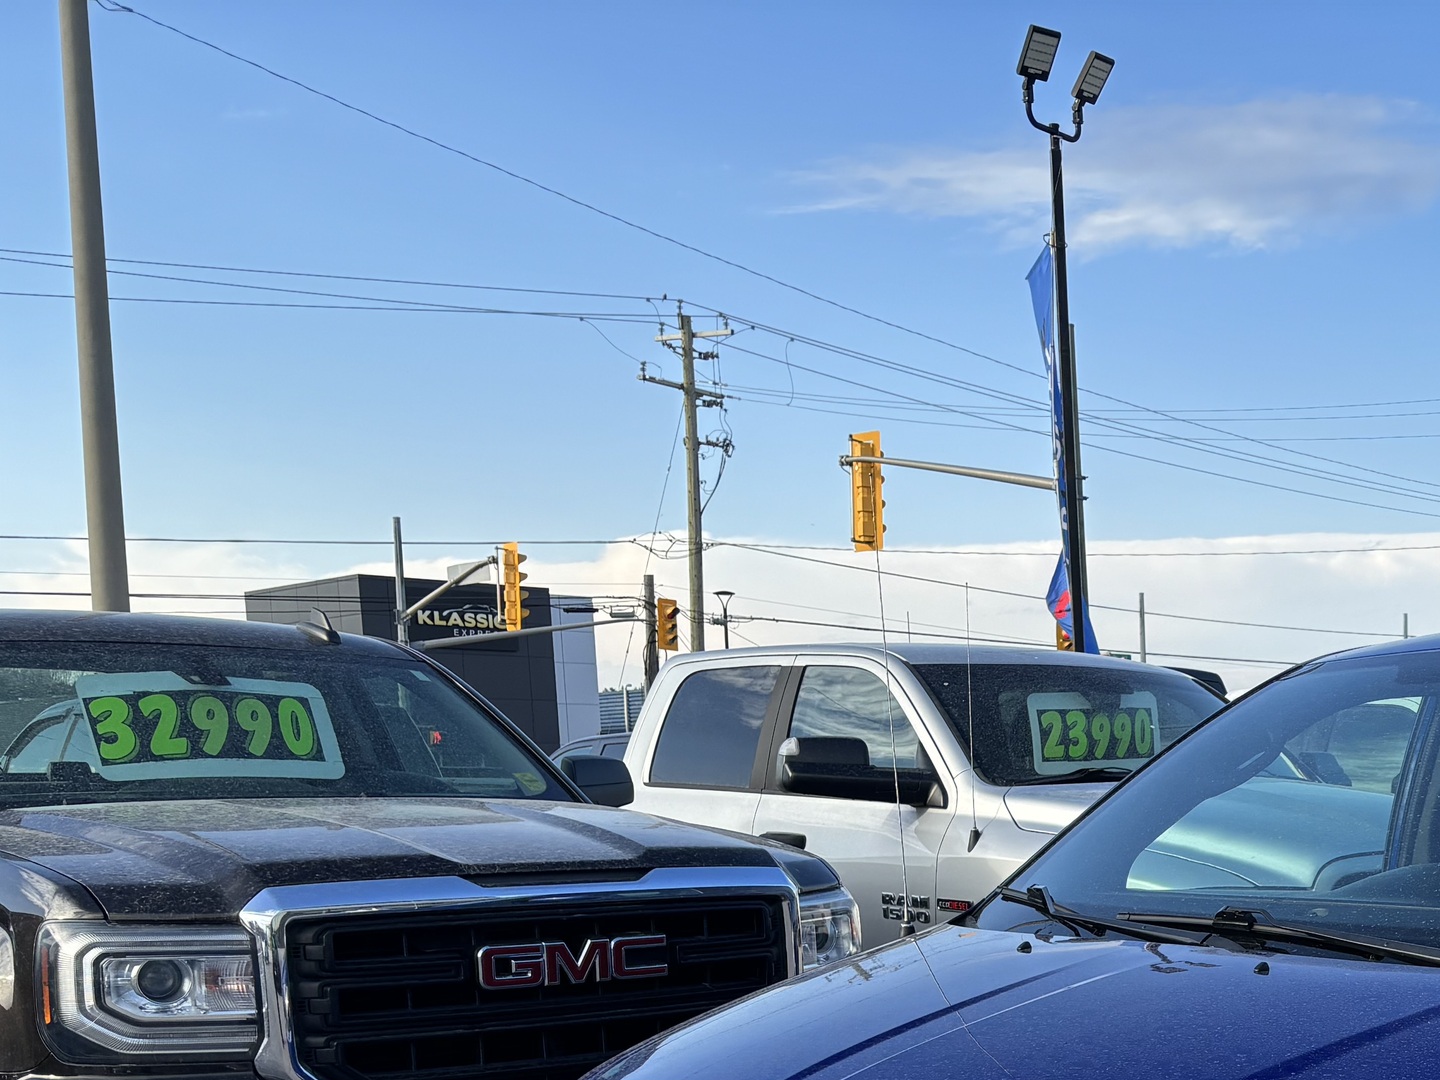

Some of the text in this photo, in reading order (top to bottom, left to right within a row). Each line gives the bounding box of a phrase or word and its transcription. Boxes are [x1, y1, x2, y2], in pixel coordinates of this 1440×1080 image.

[417, 609, 507, 630] KLASSIC
[88, 694, 318, 762] 32990
[1040, 708, 1153, 760] 23990
[881, 891, 930, 909] RAM
[882, 906, 931, 924] 1500
[477, 934, 669, 990] GMC
